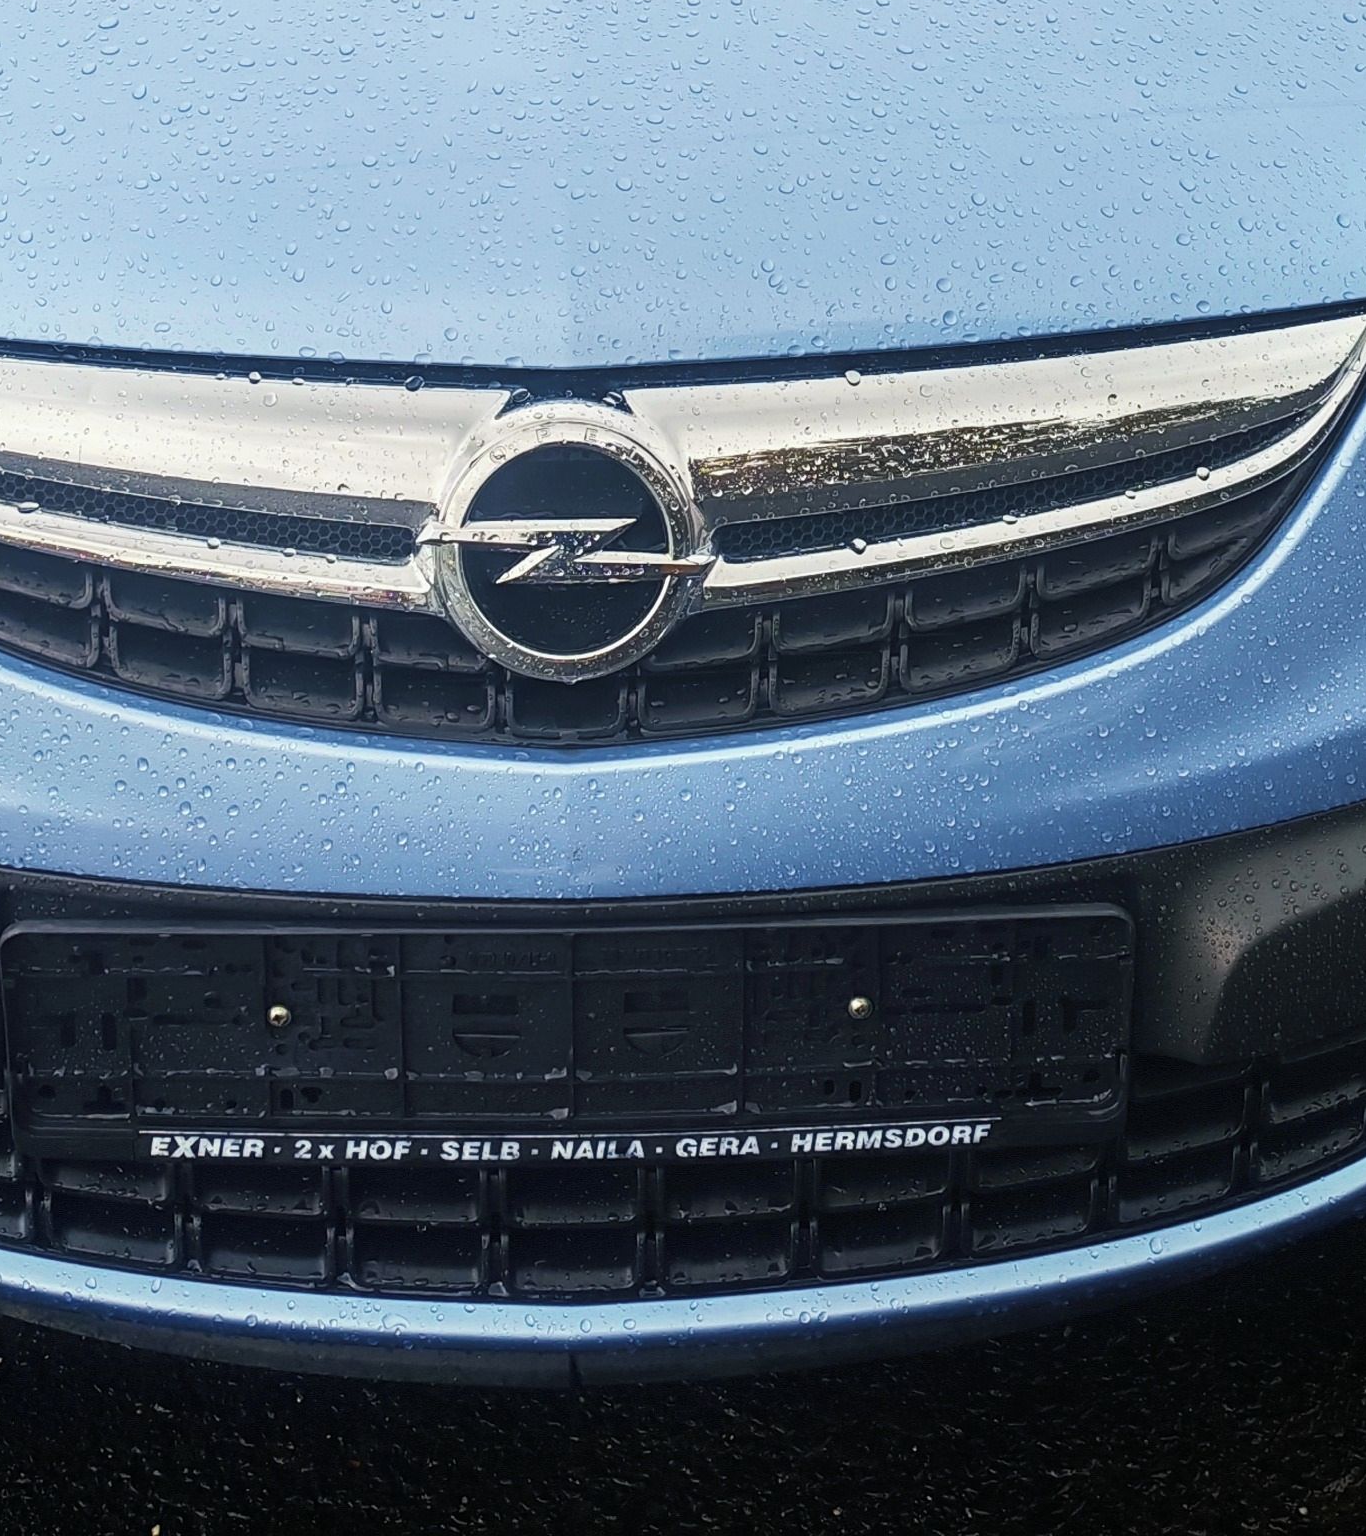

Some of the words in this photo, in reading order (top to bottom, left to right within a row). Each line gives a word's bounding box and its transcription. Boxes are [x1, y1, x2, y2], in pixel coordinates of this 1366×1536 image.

[150, 1135, 265, 1159] EXNER
[345, 1140, 412, 1161] HOF
[440, 1141, 520, 1161] SELB
[550, 1139, 645, 1159] NAILA
[675, 1135, 761, 1158] GERA
[790, 1124, 992, 1153] HERMSDORF
